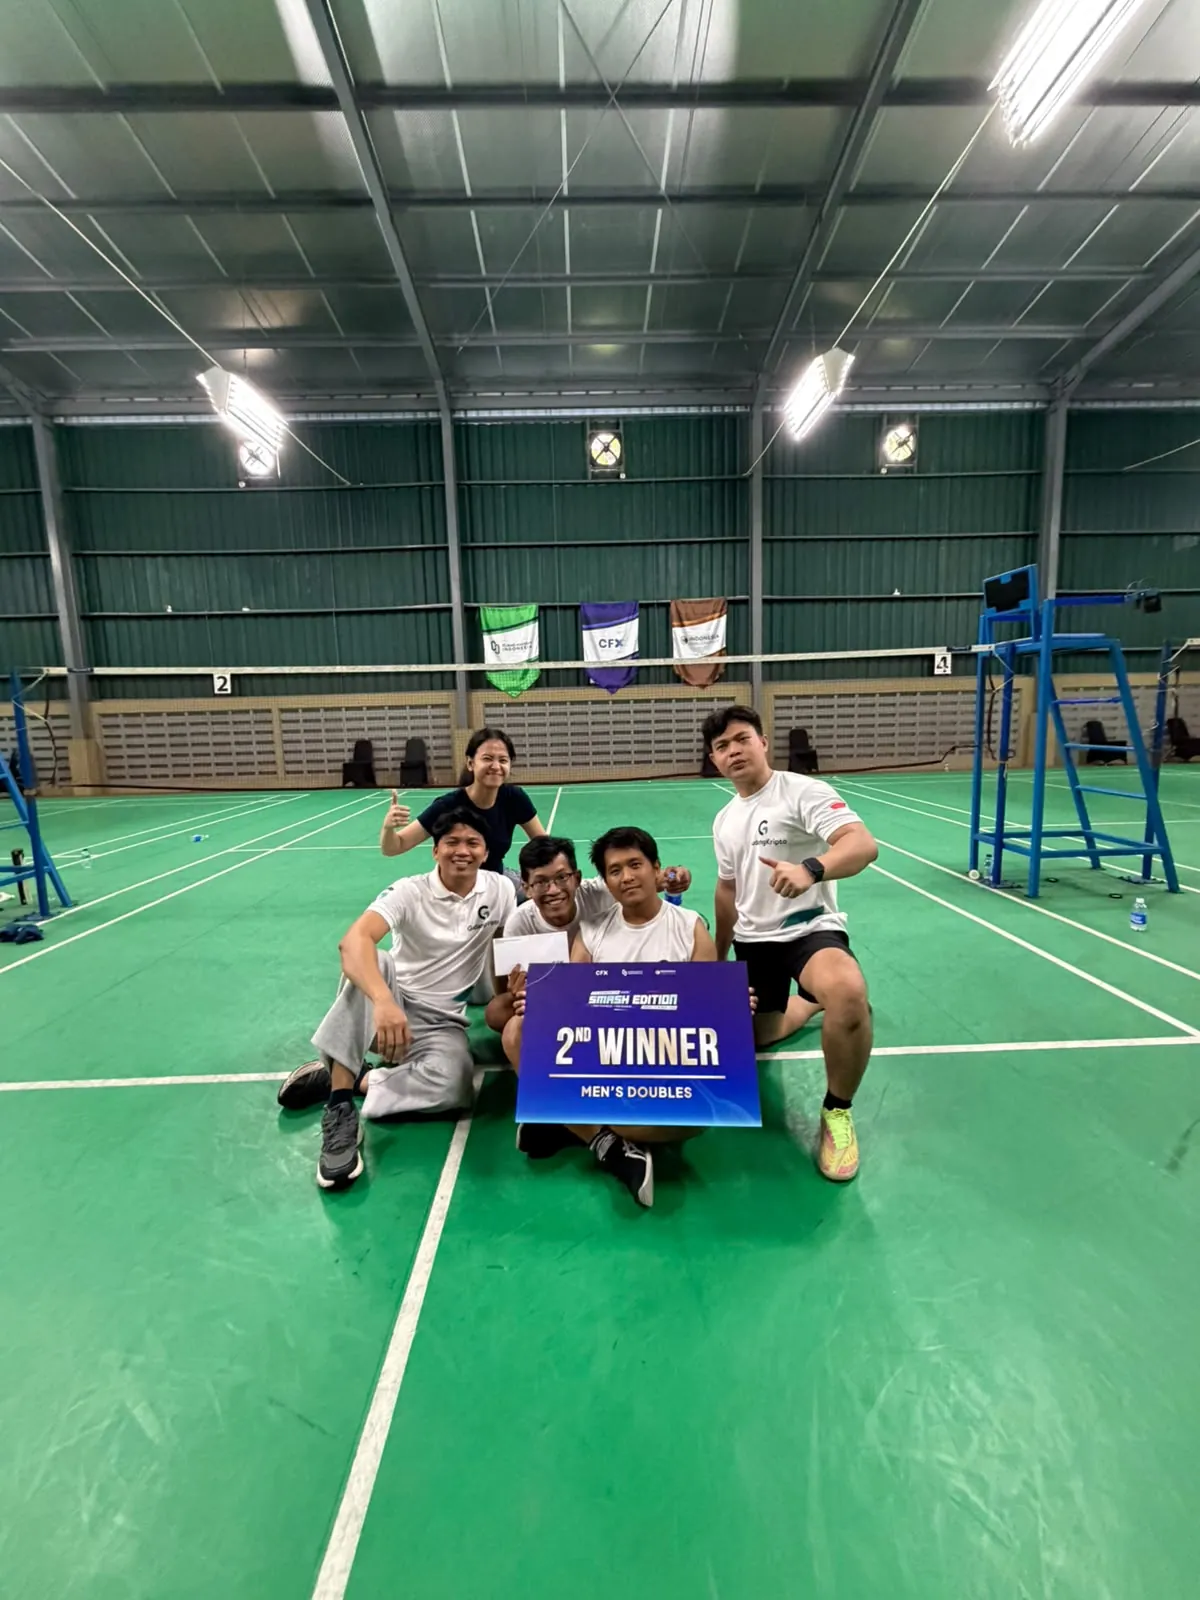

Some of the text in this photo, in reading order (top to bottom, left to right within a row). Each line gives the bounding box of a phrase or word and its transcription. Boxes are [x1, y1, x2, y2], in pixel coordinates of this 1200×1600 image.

[598, 638, 624, 649] CFX
[936, 656, 949, 673] 4
[216, 675, 229, 692] 2
[588, 993, 678, 1005] SMASH EDITION
[555, 1026, 720, 1066] 2ND WINNER
[581, 1085, 693, 1099] MEN'S DOUBLES
